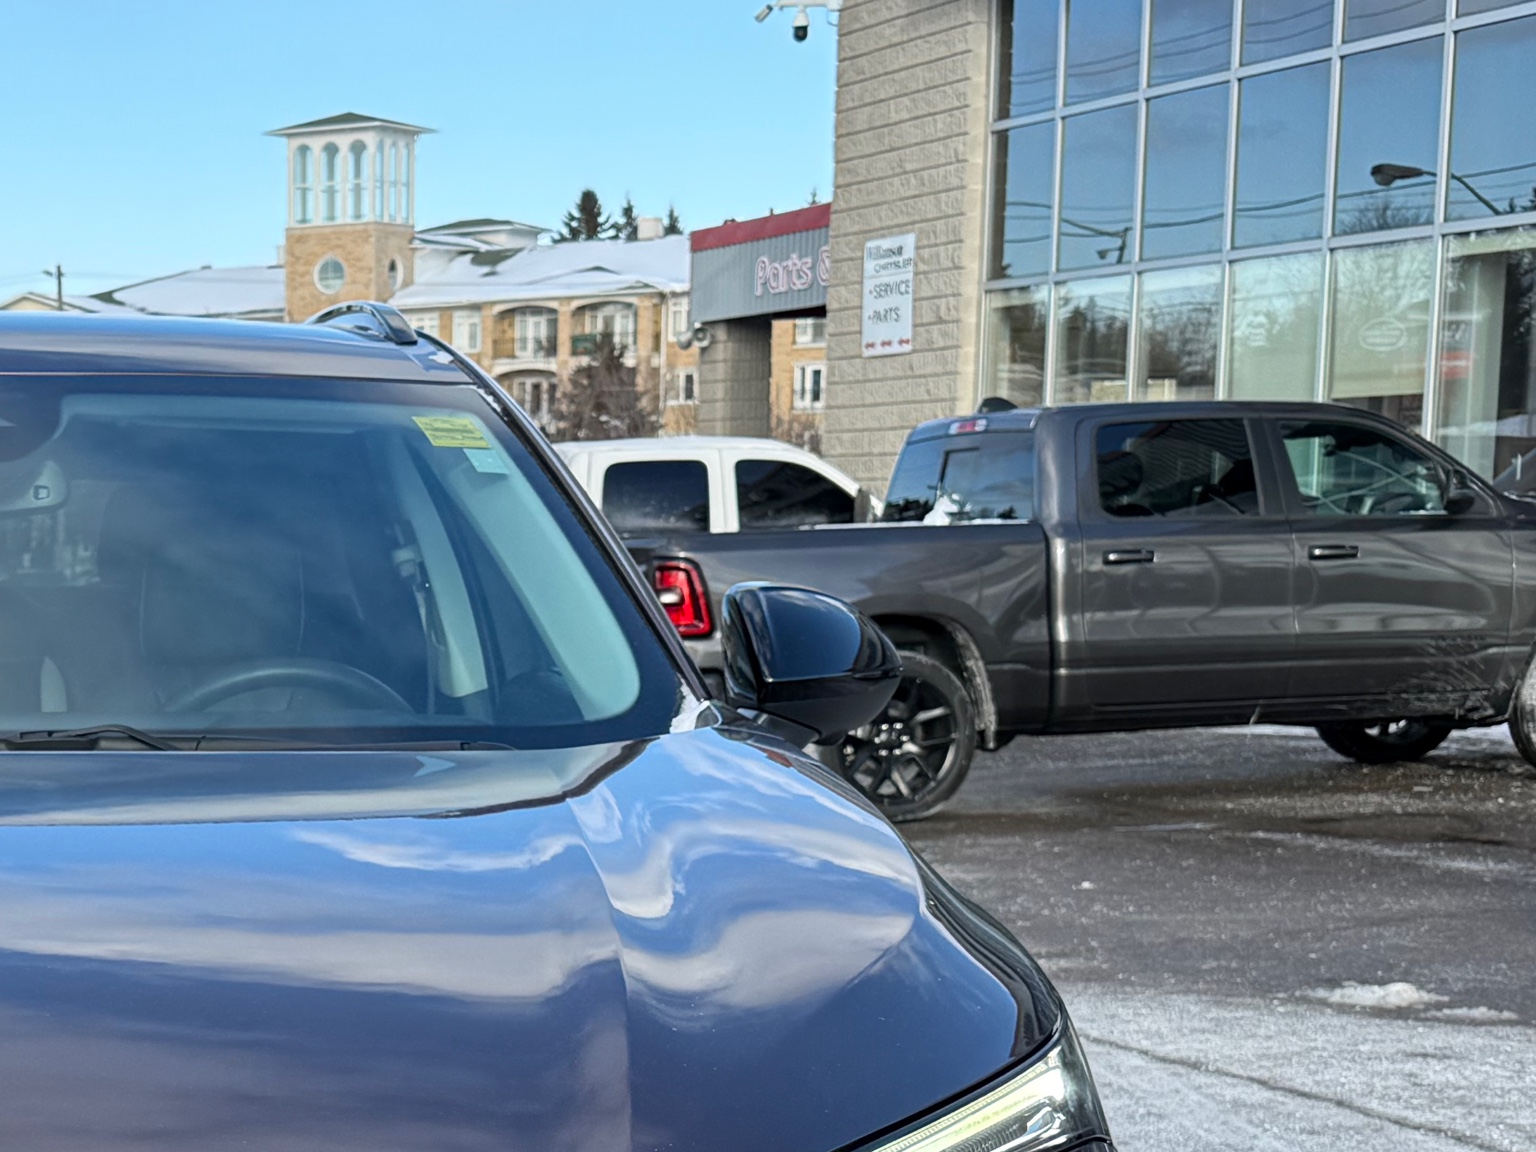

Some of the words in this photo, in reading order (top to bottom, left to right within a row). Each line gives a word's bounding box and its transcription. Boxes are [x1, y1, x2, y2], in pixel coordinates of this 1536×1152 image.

[755, 253, 813, 296] Parts
[874, 280, 911, 299] SERVICE
[872, 307, 901, 324] PARTS
